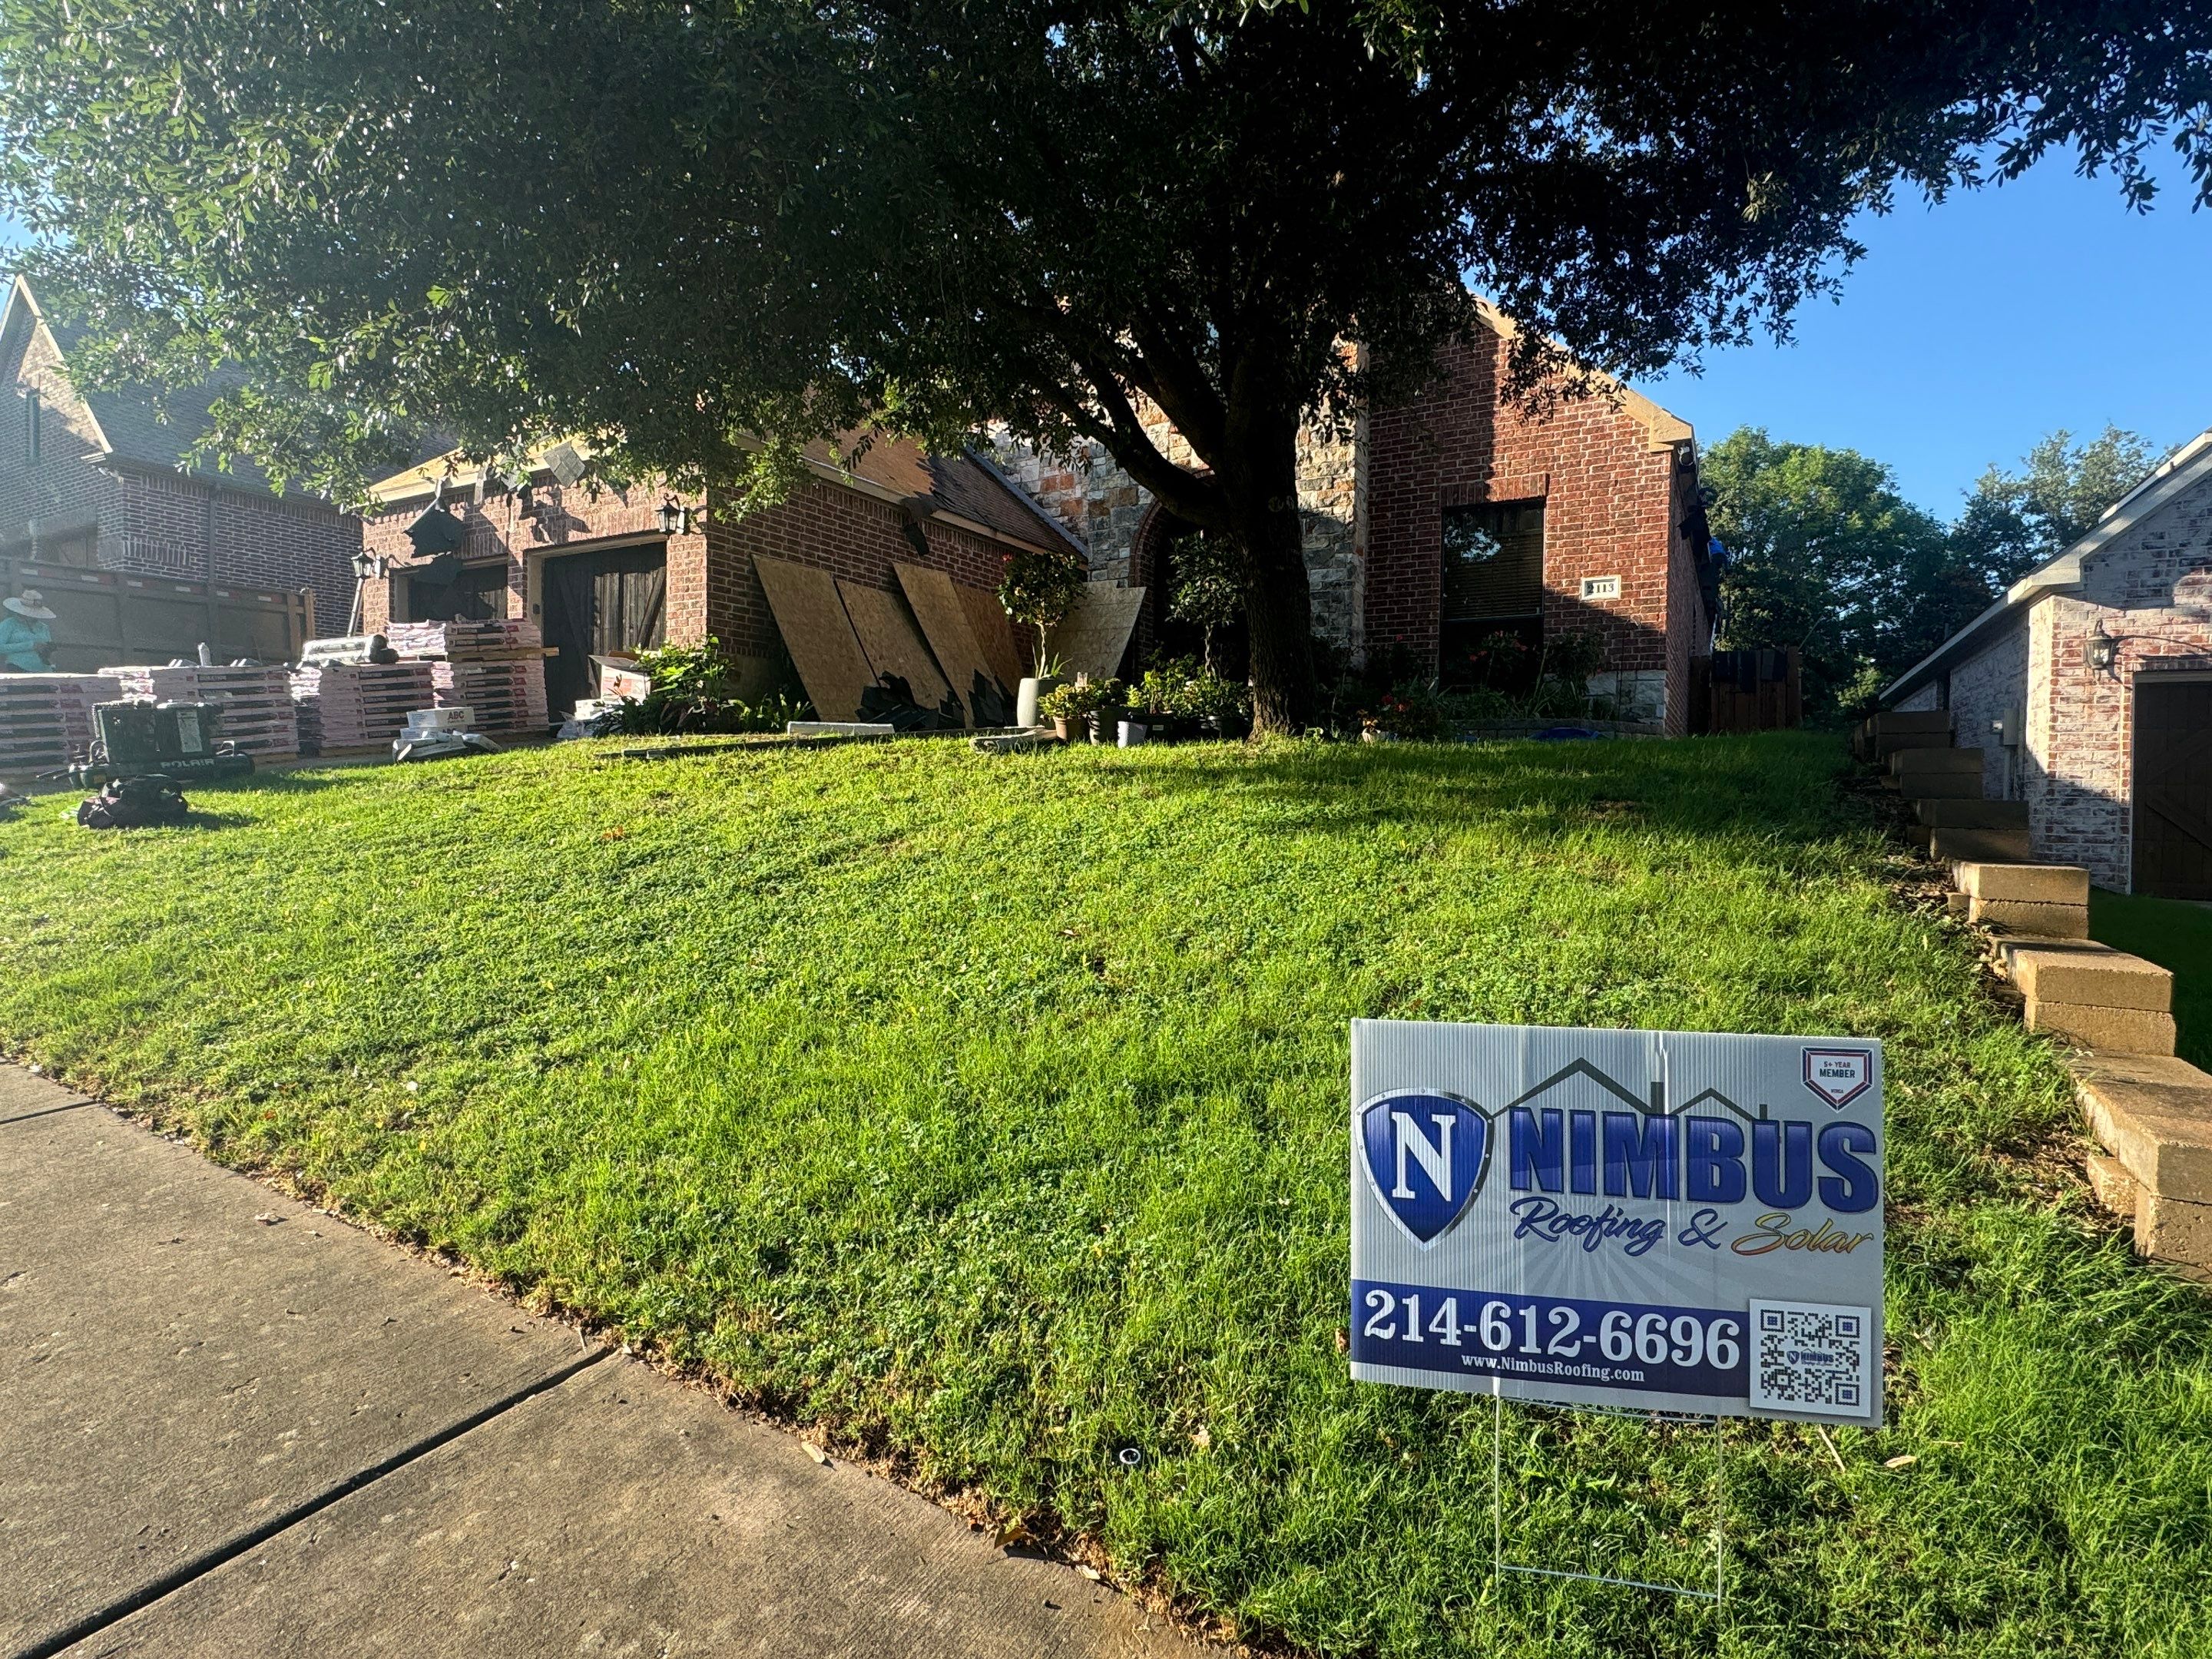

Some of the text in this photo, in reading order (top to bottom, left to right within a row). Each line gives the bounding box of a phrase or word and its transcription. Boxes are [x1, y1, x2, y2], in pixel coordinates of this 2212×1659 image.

[1587, 583, 1614, 594] 2113
[447, 710, 465, 720] ABC
[1819, 1068, 1856, 1078] MEMBER
[1391, 1111, 1456, 1203] N
[1508, 1106, 1879, 1214] NIMBUS
[1509, 1196, 1875, 1257] Roofing & Solar
[1363, 1288, 1740, 1370] 214-612-6696
[1461, 1353, 1645, 1382] www.NimbusRoofing.com
